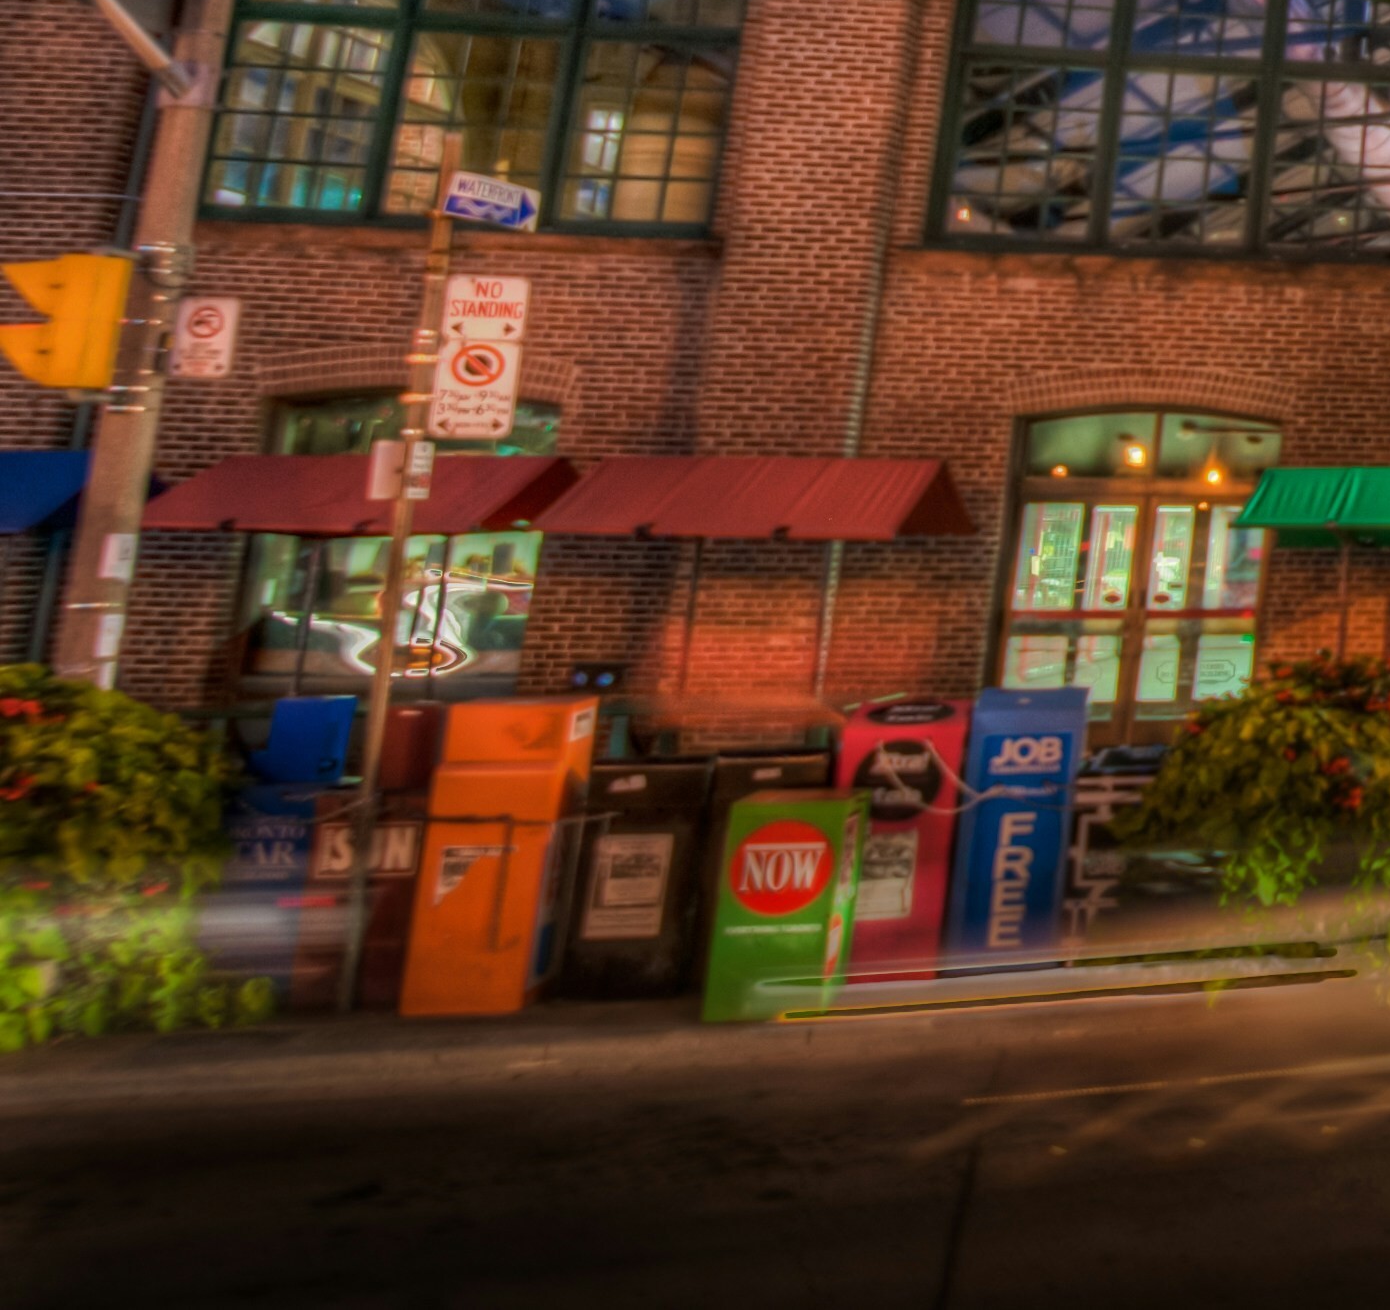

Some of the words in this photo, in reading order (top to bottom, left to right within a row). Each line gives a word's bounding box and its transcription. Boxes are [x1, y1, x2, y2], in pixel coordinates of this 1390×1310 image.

[456, 175, 521, 208] WATERFRONT
[475, 281, 503, 299] NO
[450, 299, 525, 319] STANDING
[988, 737, 1063, 766] JOB
[737, 846, 826, 893] NOW
[987, 811, 1037, 947] FREE
